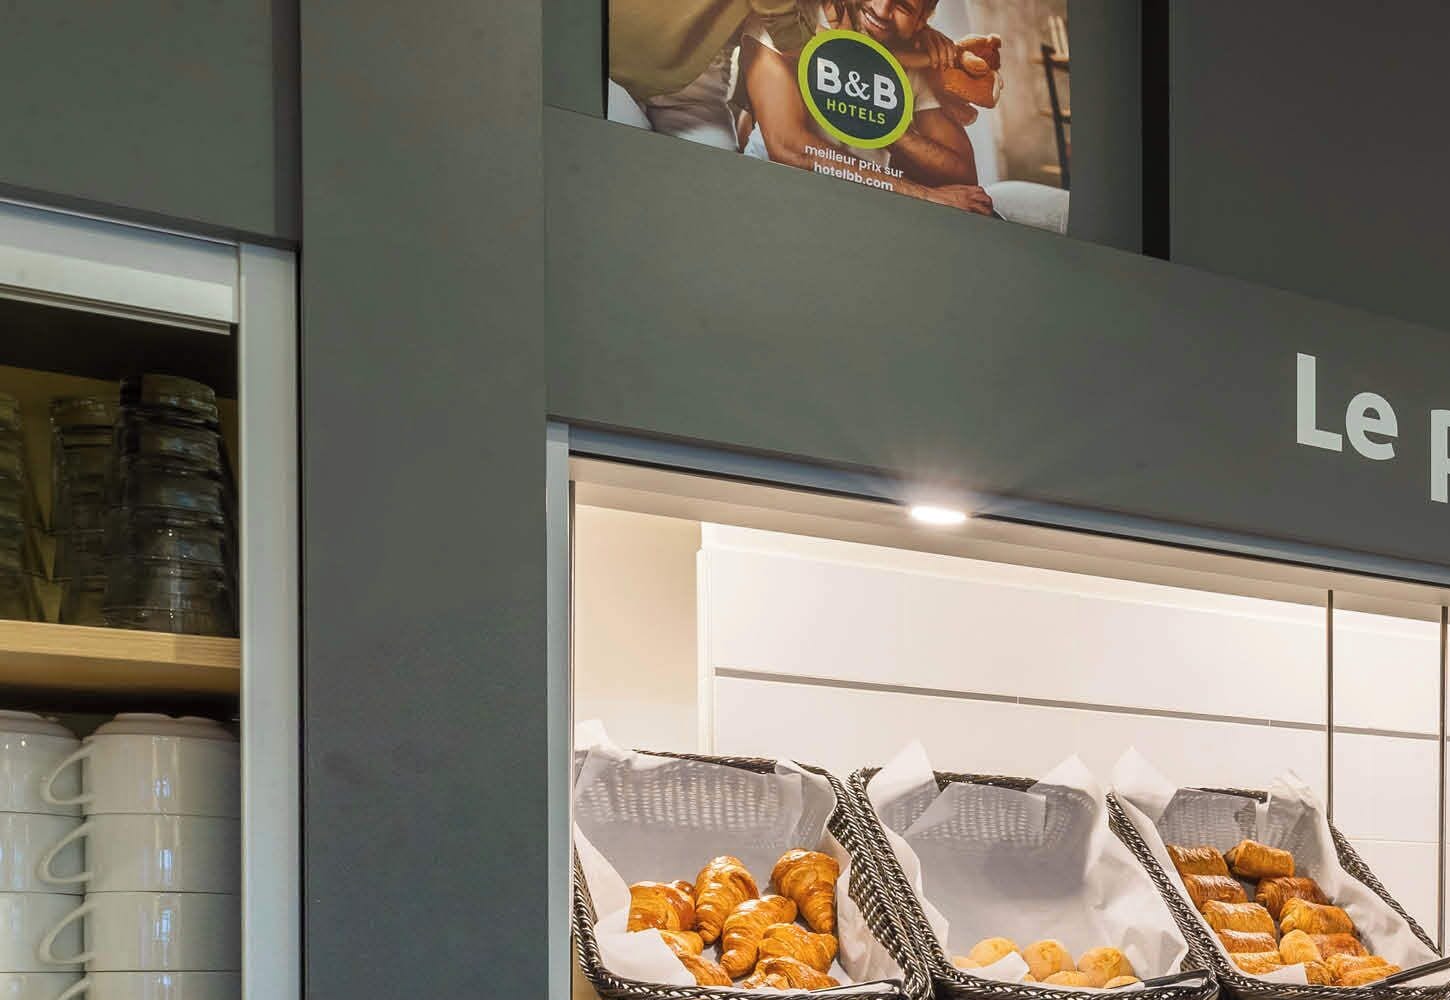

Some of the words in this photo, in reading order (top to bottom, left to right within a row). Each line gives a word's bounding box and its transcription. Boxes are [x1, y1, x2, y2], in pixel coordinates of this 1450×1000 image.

[815, 57, 898, 111] B&B
[827, 98, 886, 126] HOTELS
[805, 145, 856, 166] meilleur
[859, 159, 882, 173] prix
[884, 167, 905, 178] sur
[814, 161, 894, 191] hotelbb.com
[1297, 352, 1399, 461] Le
